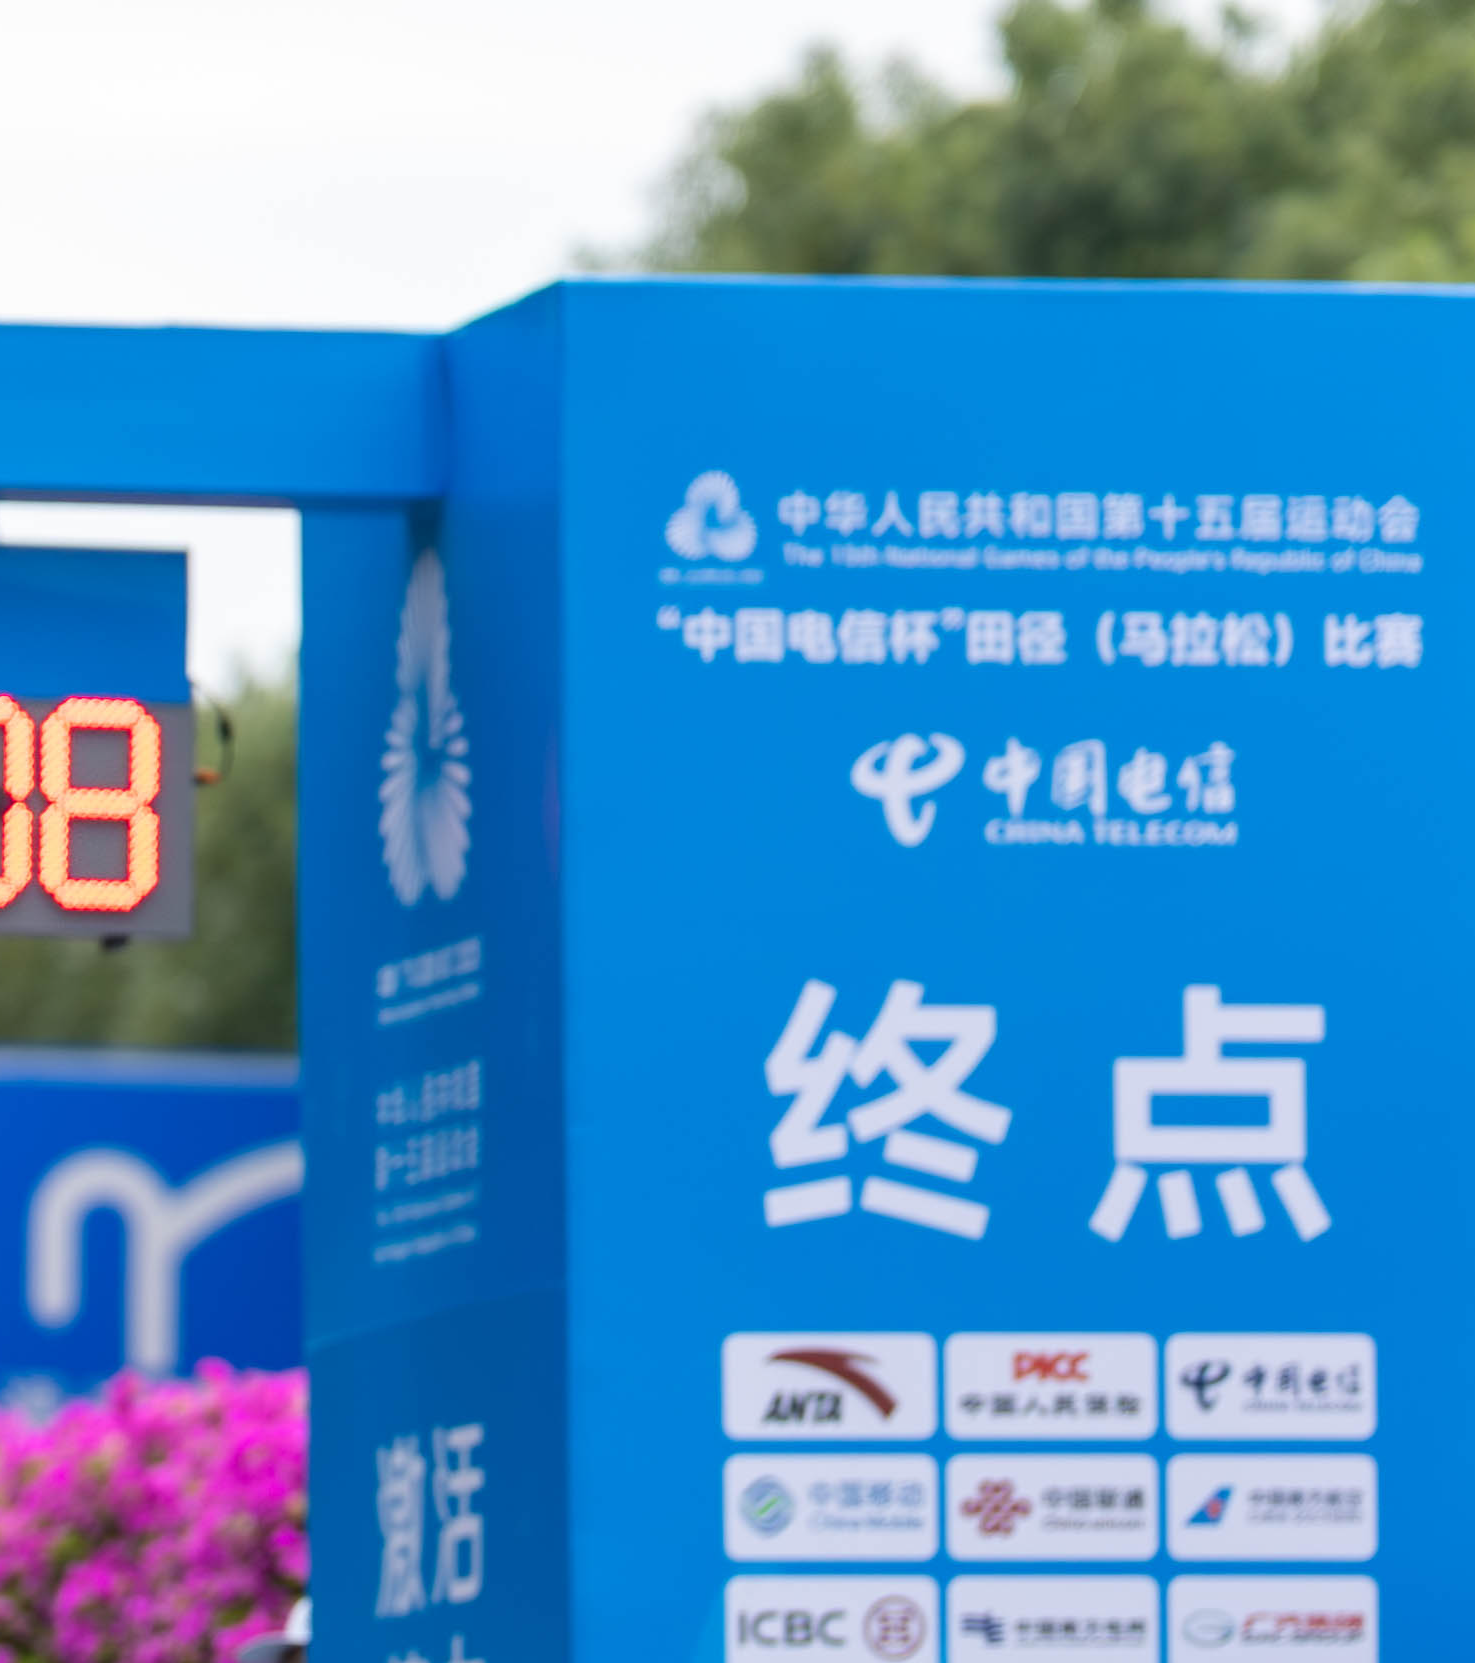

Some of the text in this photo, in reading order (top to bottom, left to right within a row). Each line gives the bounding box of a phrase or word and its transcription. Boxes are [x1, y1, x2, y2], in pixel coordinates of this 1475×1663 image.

[778, 490, 1421, 543] 中华人民共和国第十五届运动会
[784, 542, 825, 568] The
[983, 737, 1237, 819] 中国电信
[985, 819, 1240, 847] CHINA TELECOM
[763, 978, 1333, 1242] 终点
[737, 1609, 847, 1648] ICBC
